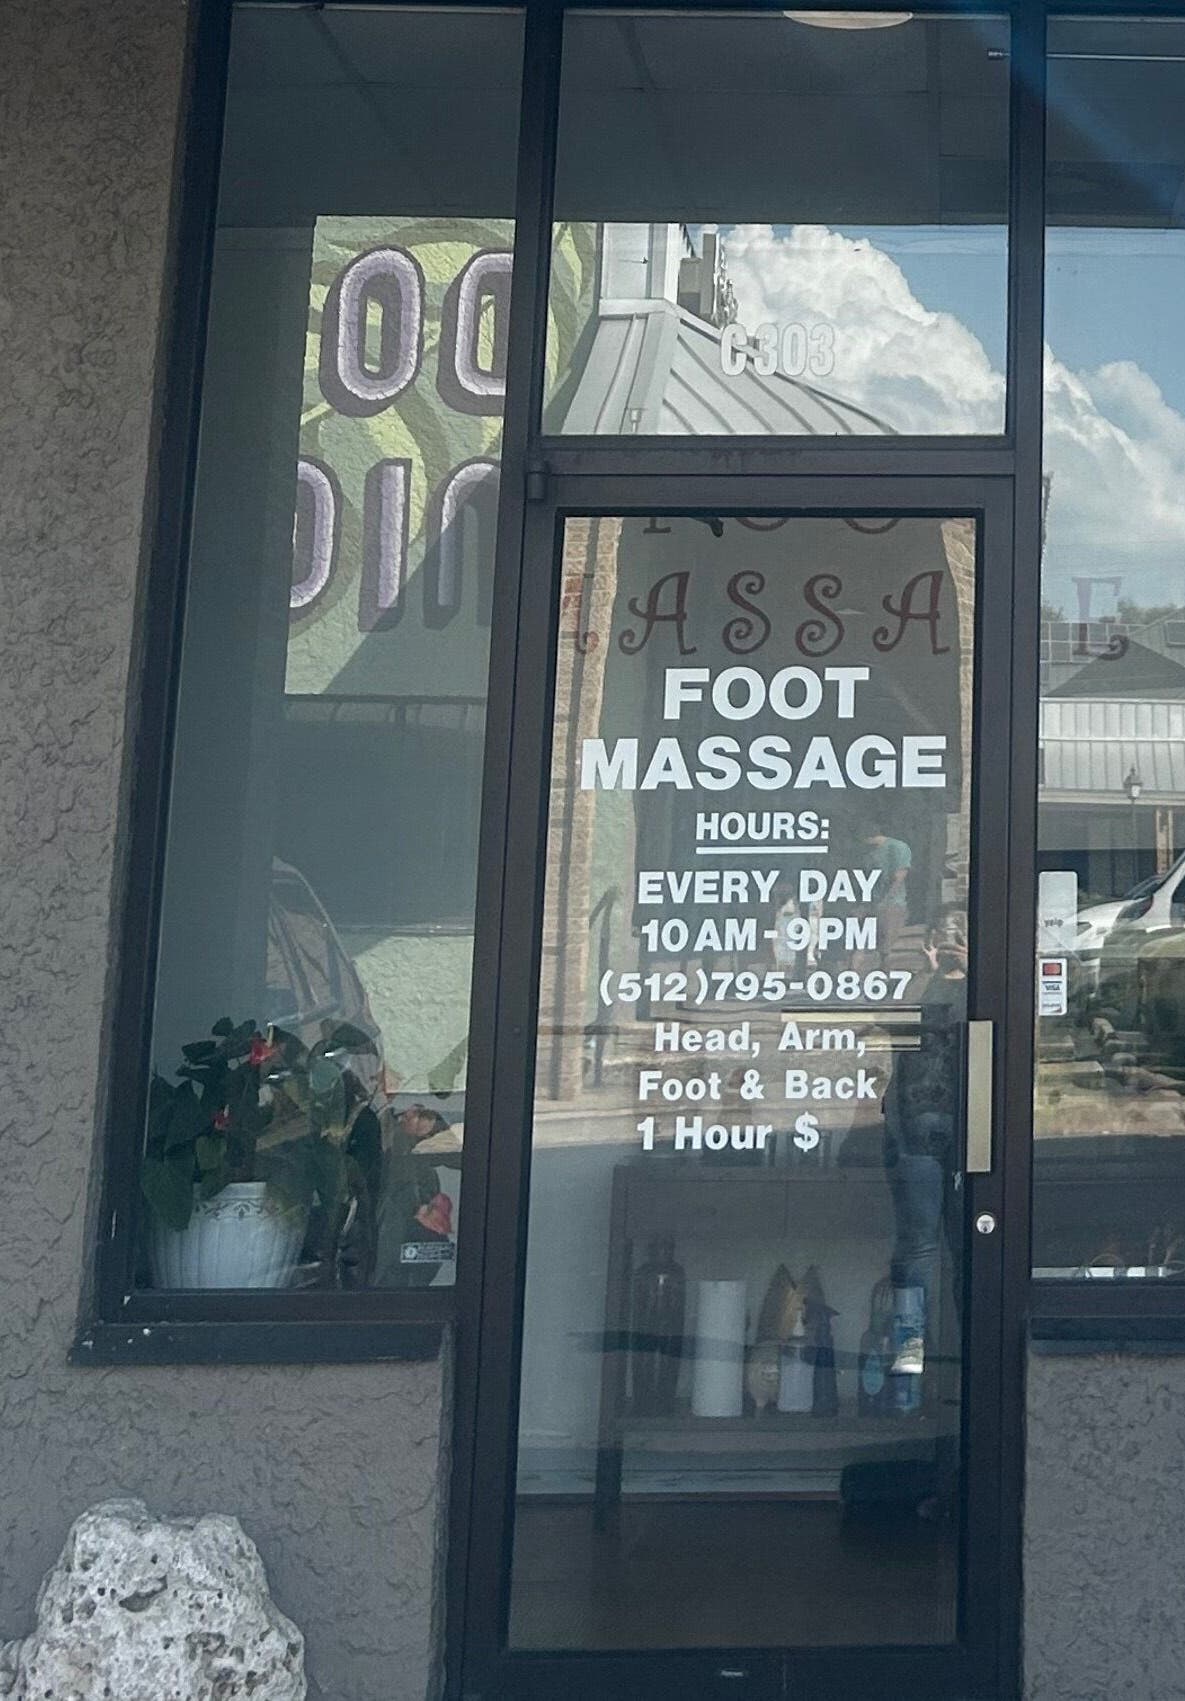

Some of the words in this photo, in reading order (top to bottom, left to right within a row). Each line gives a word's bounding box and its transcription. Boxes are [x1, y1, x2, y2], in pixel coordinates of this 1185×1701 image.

[663, 666, 870, 720] FOOT
[580, 734, 947, 791] MASSAGE
[695, 811, 830, 842] HOURS:
[638, 870, 780, 904] EVERY
[800, 869, 882, 902] DAY
[599, 970, 913, 1006] (512)795-0867
[654, 1022, 761, 1058] Head,
[777, 1022, 867, 1057] Arm,
[639, 1070, 722, 1101] Foot
[740, 1069, 765, 1100] &
[785, 1069, 878, 1100] Back
[637, 1117, 655, 1150] 1
[674, 1116, 772, 1150] Hour
[793, 1111, 820, 1152] $
